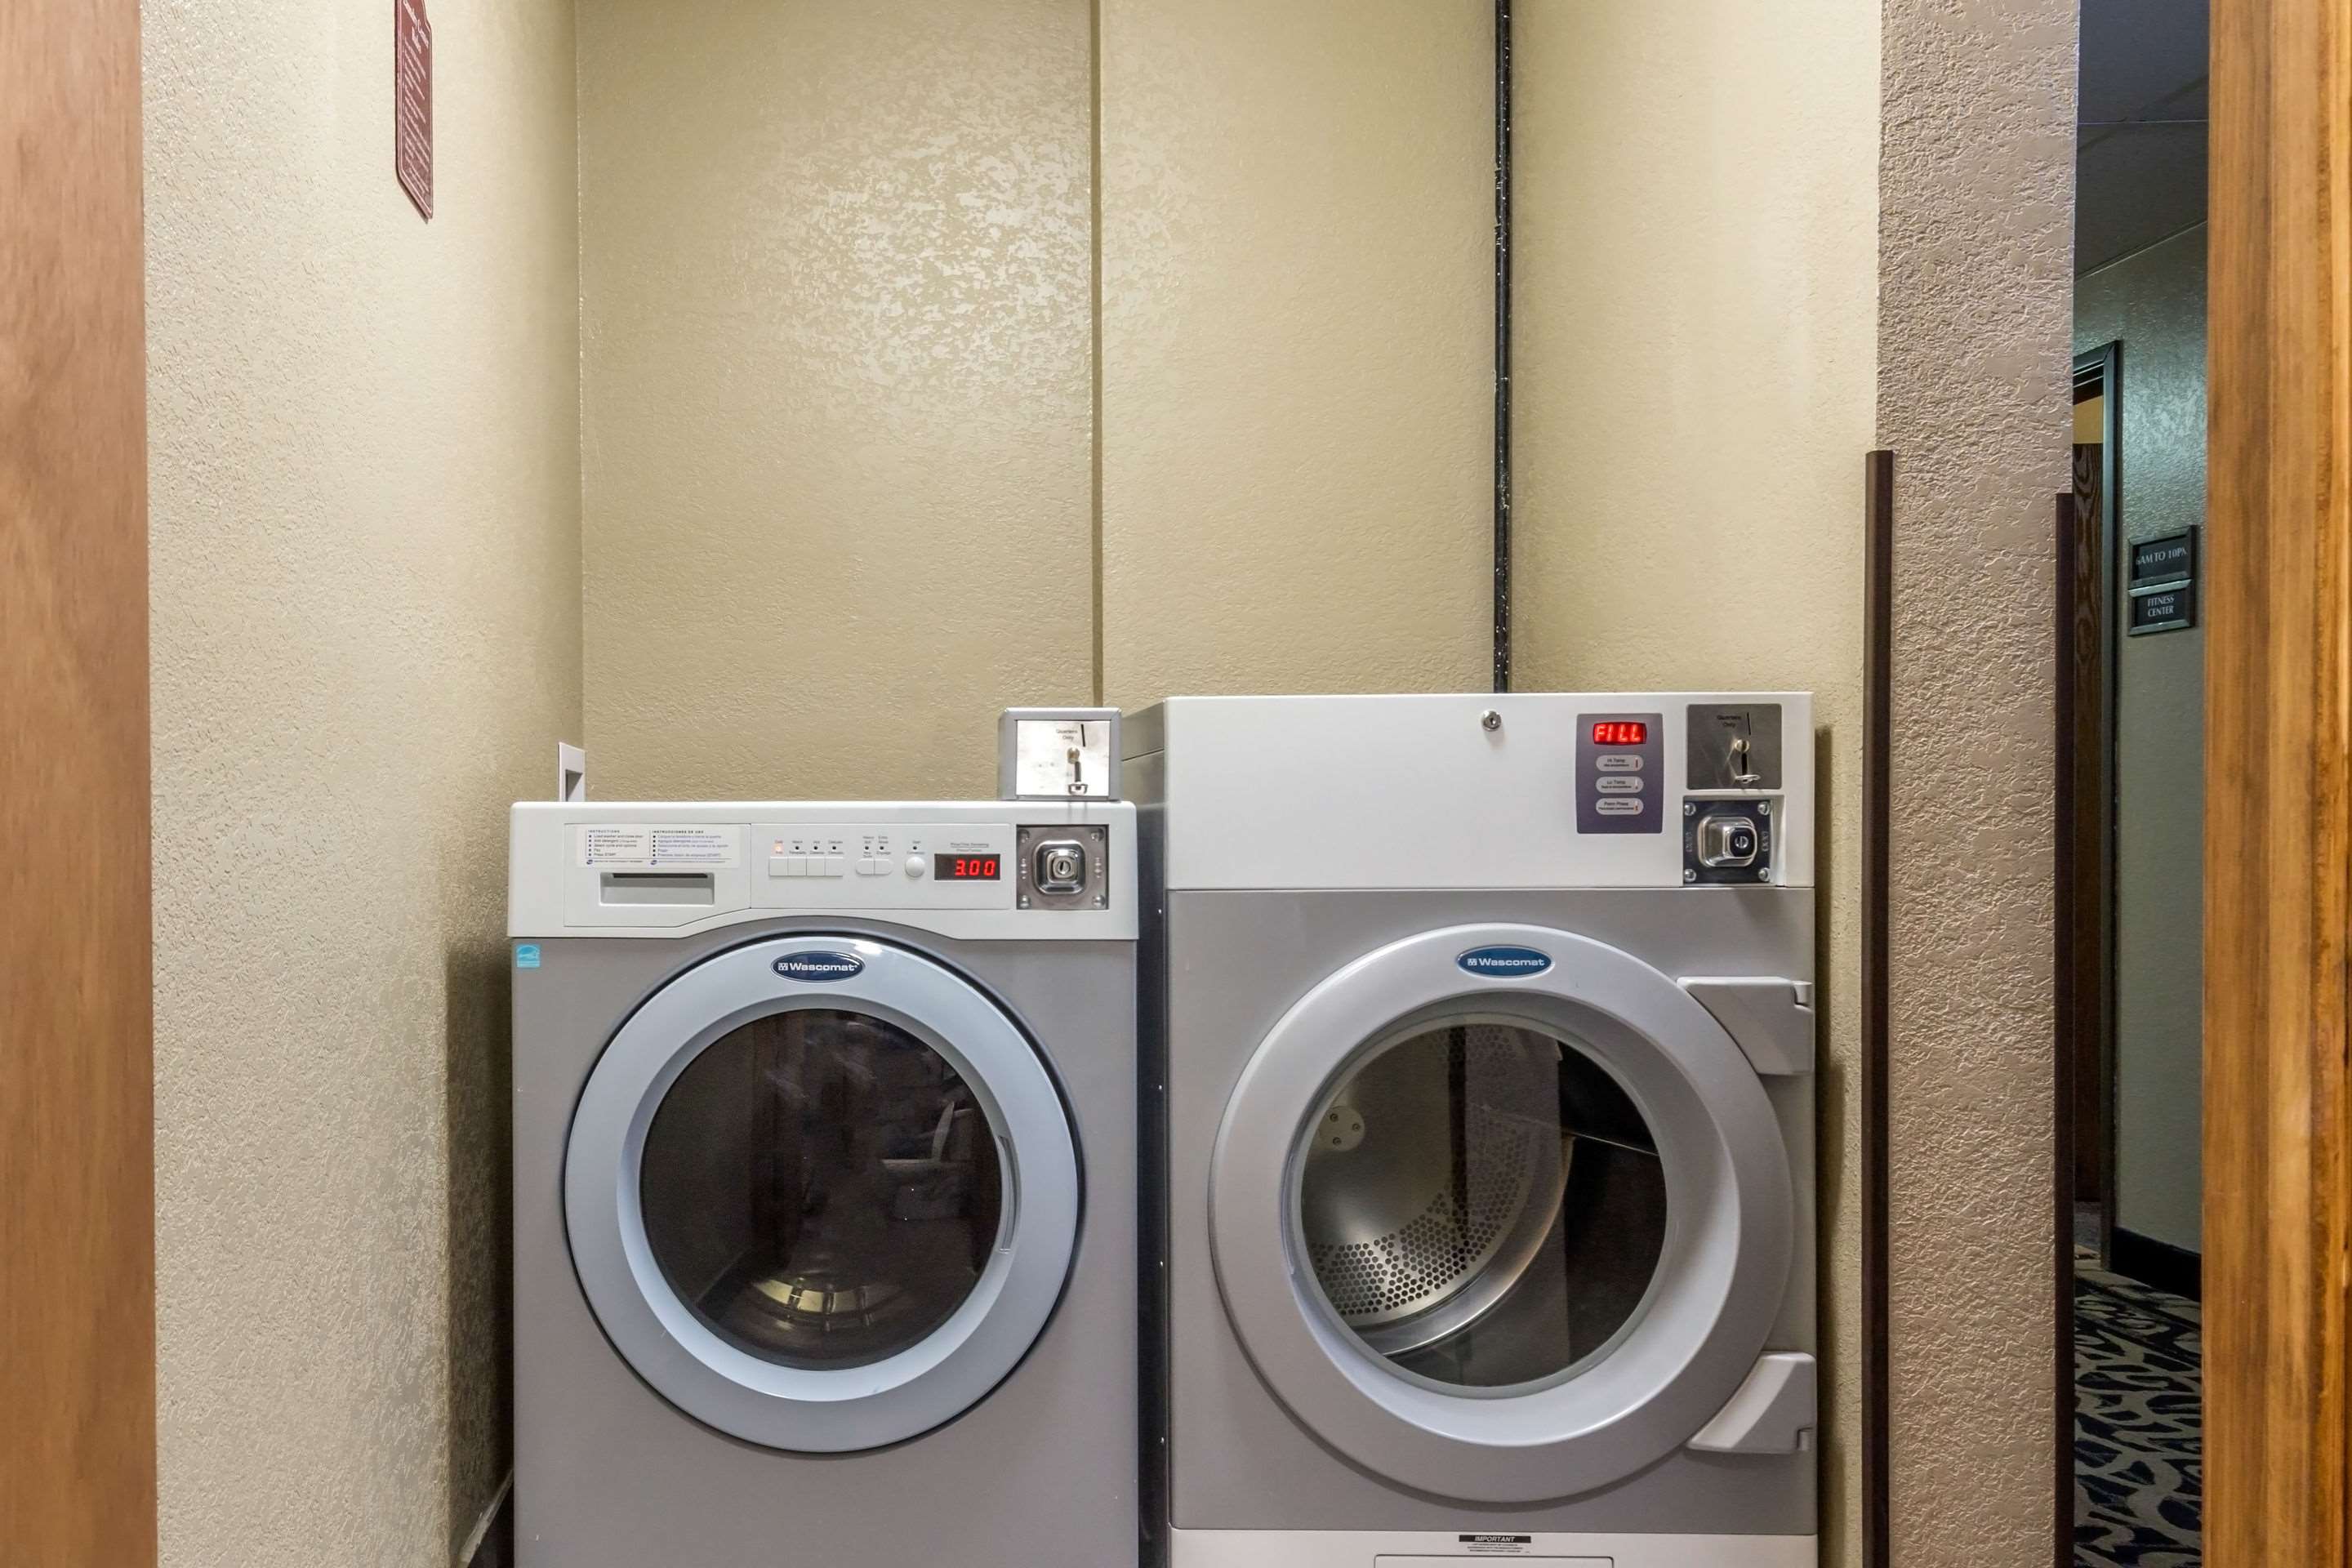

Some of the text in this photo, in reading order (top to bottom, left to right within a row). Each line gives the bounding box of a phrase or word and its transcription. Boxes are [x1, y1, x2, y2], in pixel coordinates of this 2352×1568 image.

[2154, 550, 2166, 562] TO
[2147, 595, 2174, 607] FITNESS
[2148, 605, 2174, 617] CENTER
[1595, 724, 1641, 742] FILL
[789, 962, 855, 972] Wascomat
[1478, 957, 1545, 967] Wascomat
